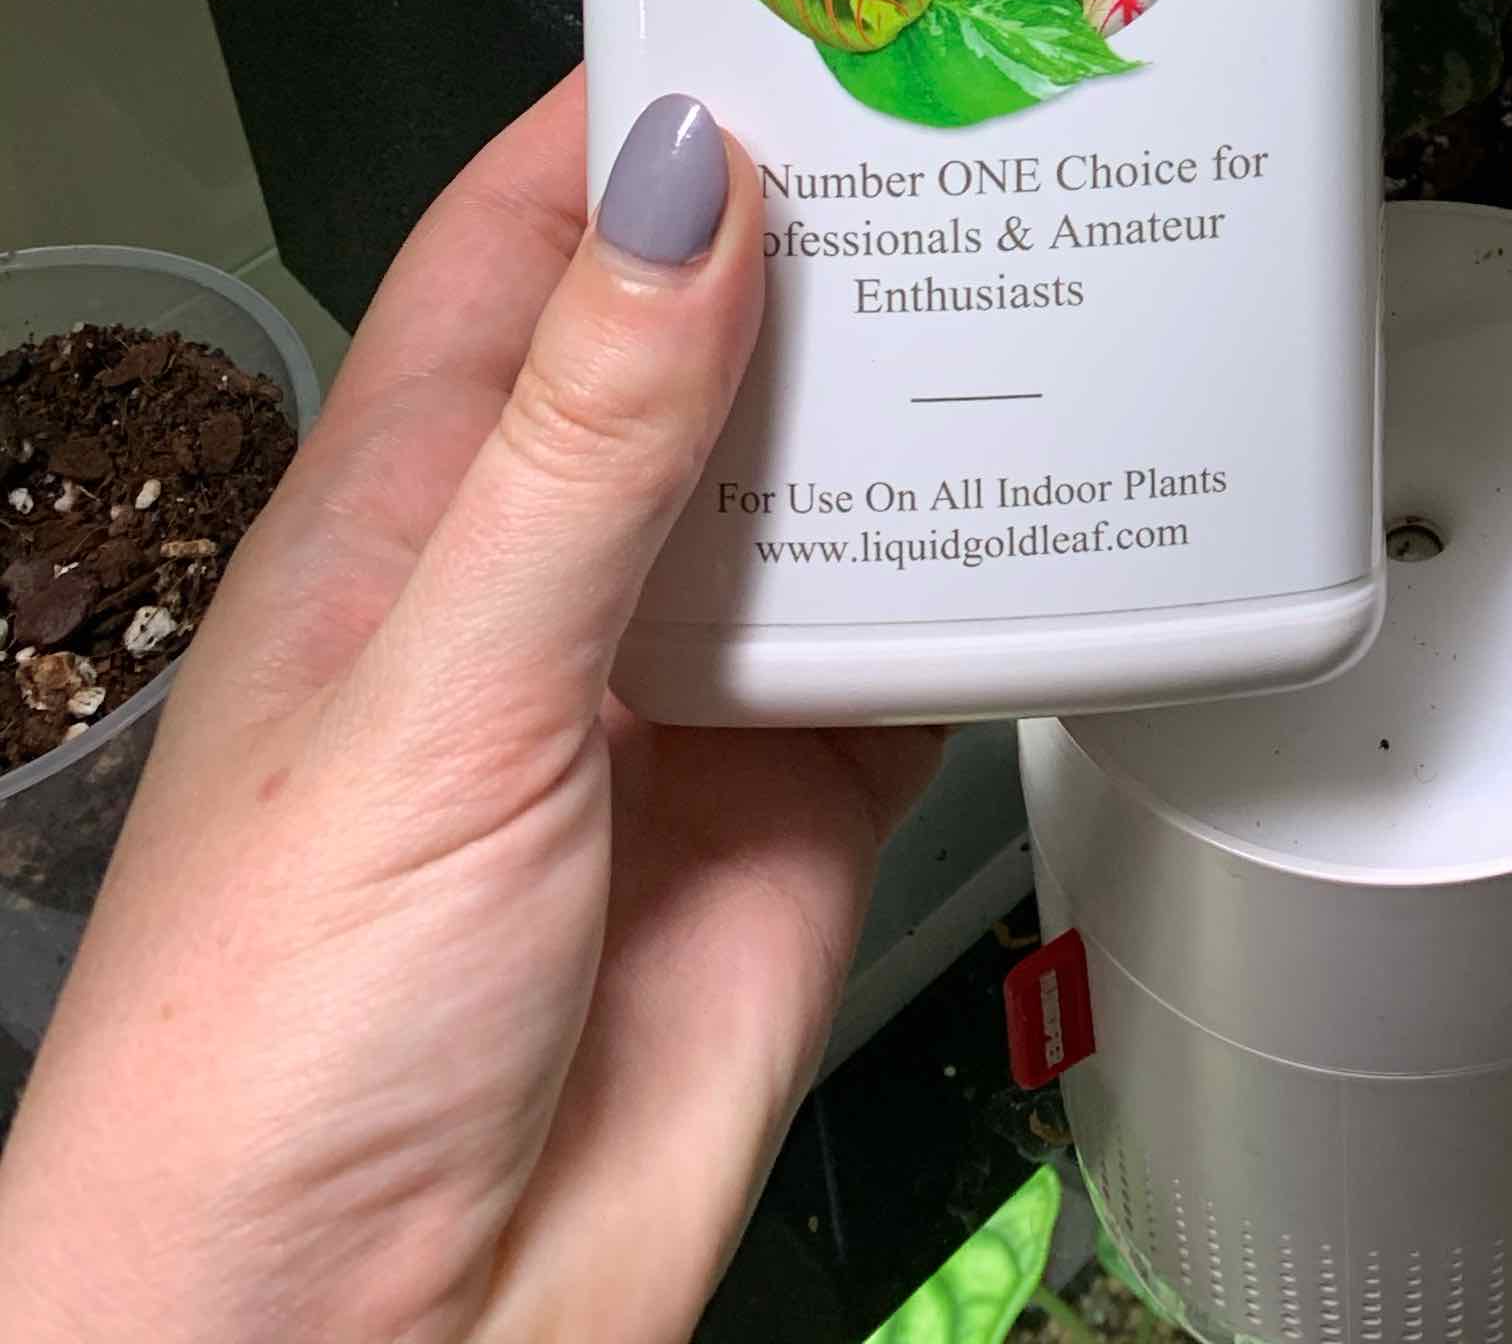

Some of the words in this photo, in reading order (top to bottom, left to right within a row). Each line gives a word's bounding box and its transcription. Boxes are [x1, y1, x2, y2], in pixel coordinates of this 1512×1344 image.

[757, 160, 926, 201] Number
[937, 157, 1042, 197] ONE
[1055, 149, 1198, 193] Choice
[1211, 143, 1270, 183] for
[763, 216, 983, 259] ofessionals
[995, 215, 1035, 253] &
[1047, 211, 1227, 251] Amateur
[852, 273, 1085, 315] Enthusiasts
[716, 482, 776, 515] For
[786, 482, 856, 515] Use
[864, 481, 919, 514] On
[928, 477, 984, 513] All
[996, 474, 1113, 510] Indoor
[1123, 466, 1228, 502] Plants
[754, 519, 1190, 572] www.liquidgoldleaf.com
